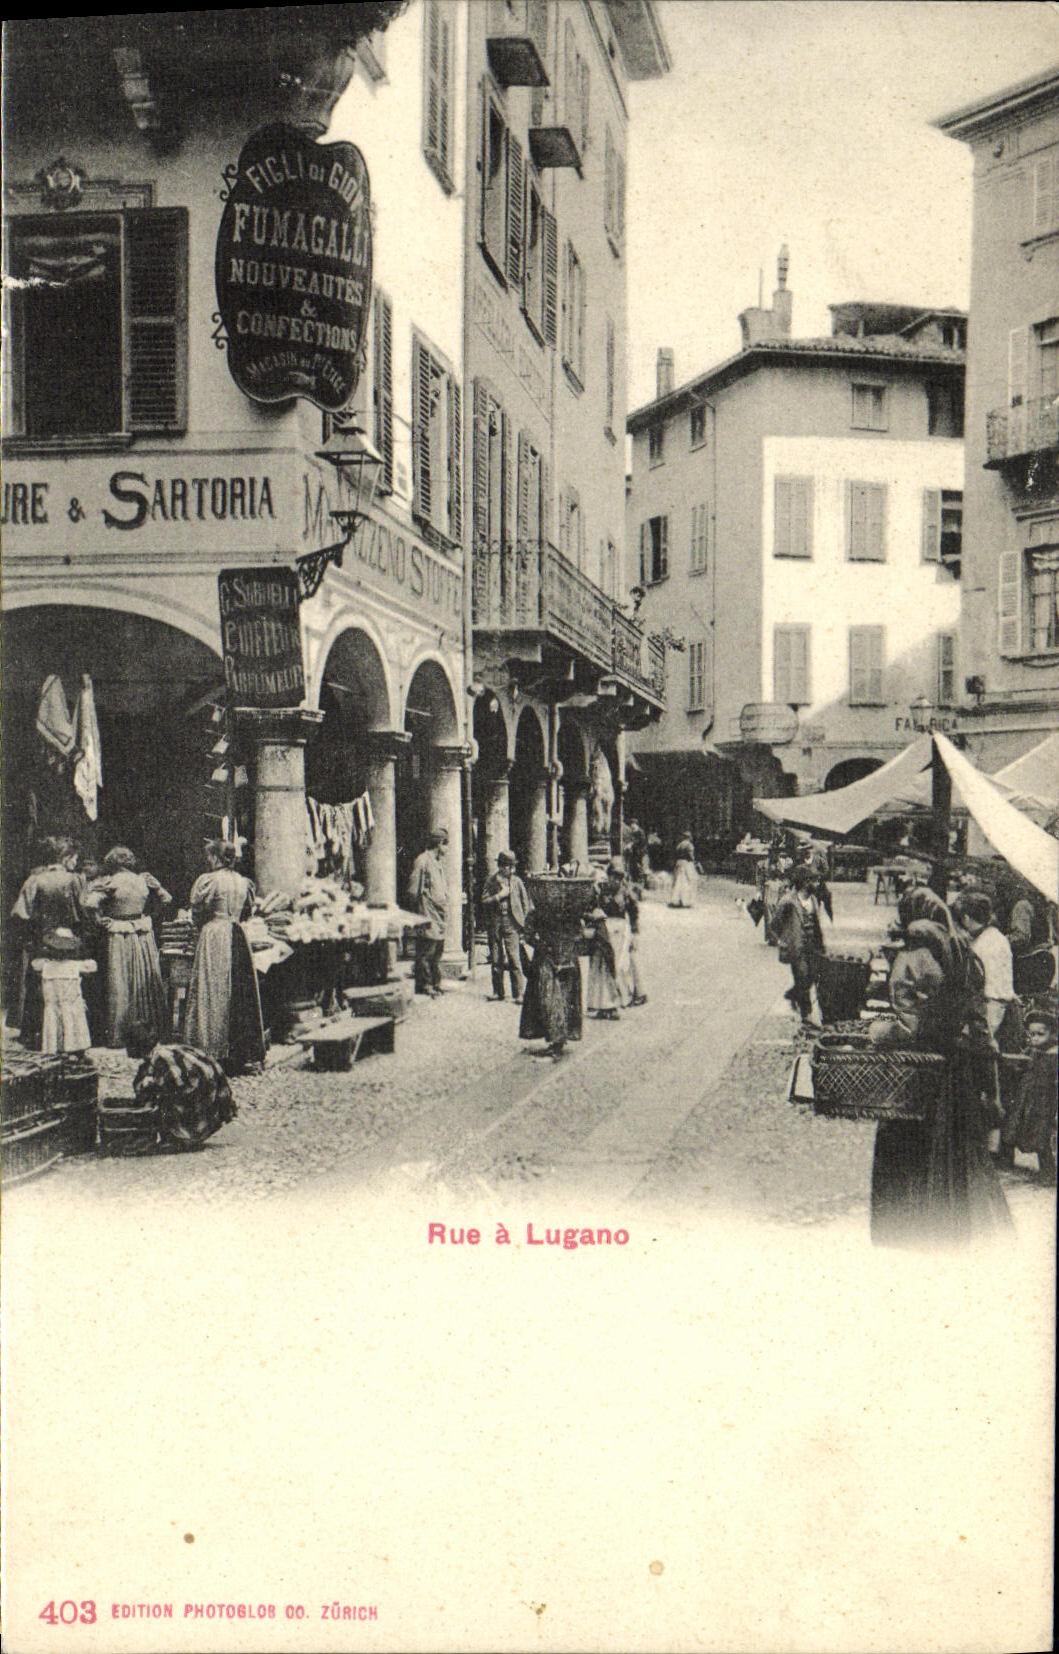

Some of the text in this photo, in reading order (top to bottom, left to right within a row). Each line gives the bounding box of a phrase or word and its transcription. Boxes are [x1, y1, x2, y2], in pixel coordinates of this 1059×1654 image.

[246, 150, 303, 194] FIGLI
[231, 203, 369, 268] FUMAGALLI
[300, 299, 317, 318] &
[236, 310, 357, 352] CONFECTIONS
[67, 497, 86, 523] &
[101, 470, 277, 530] SARTORIA
